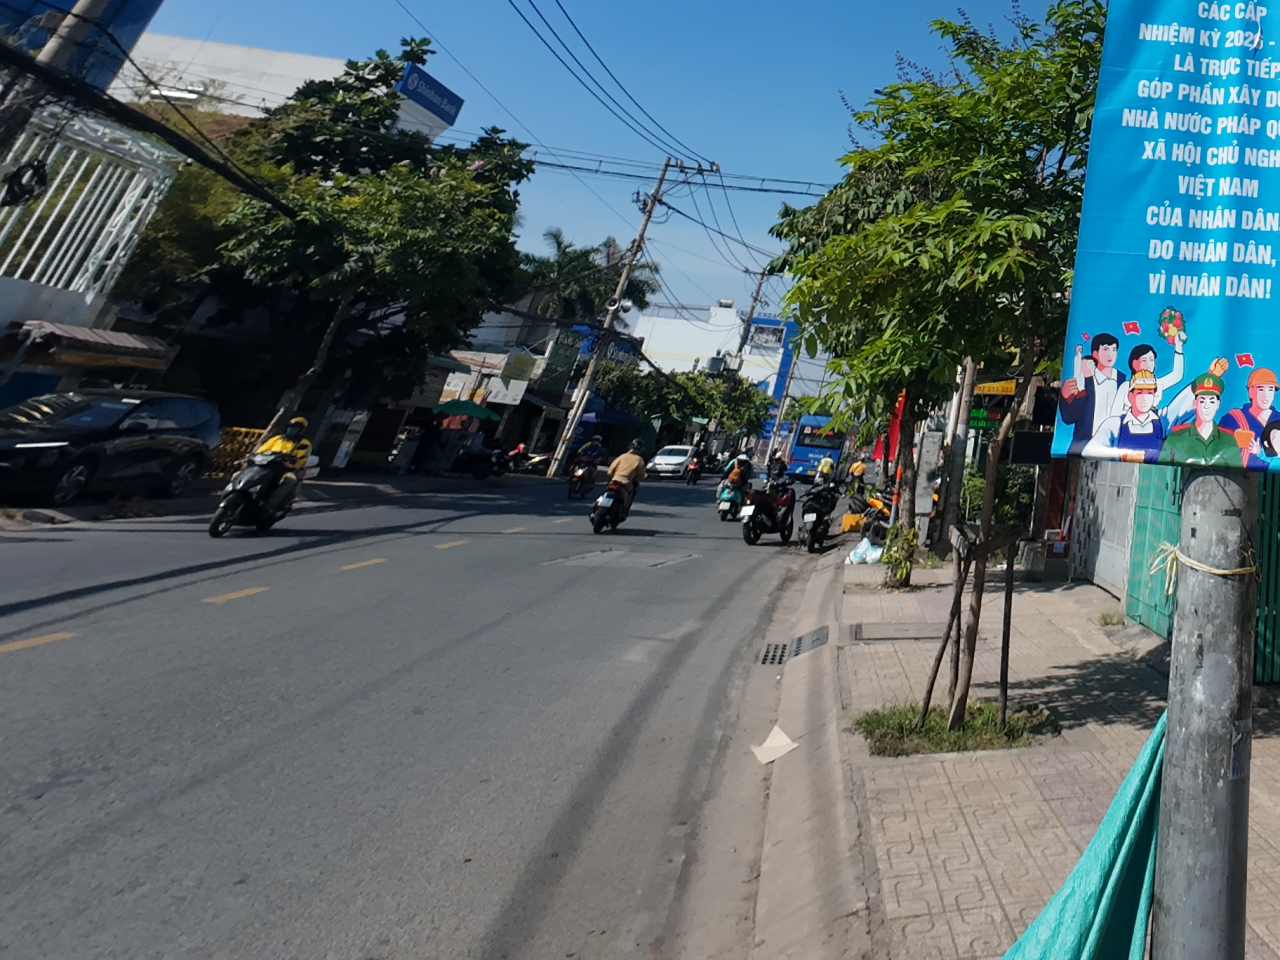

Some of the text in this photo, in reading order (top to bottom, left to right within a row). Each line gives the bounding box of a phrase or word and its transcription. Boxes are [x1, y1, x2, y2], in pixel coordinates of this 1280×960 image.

[1197, 0, 1267, 21] CÁC CẤP
[1139, 22, 1195, 46] NHIỆM
[1200, 27, 1221, 48] KỲ
[1174, 53, 1195, 73] LÀ
[1200, 57, 1240, 80] TRỰC
[1137, 77, 1173, 100] GÓP
[1177, 81, 1224, 105] PHẦN
[1228, 86, 1261, 106] XÂY
[1121, 107, 1159, 129] NHÀ
[1164, 112, 1212, 134] NƯỚC
[1216, 113, 1261, 135] PHÁP
[1141, 138, 1166, 160] XÃ
[1171, 141, 1200, 167] HỘI
[1206, 140, 1239, 166] CHỦ
[1178, 174, 1259, 200] VIỆT NAM
[1145, 200, 1183, 227] CỦA
[1188, 205, 1236, 229] NHÂN
[1148, 239, 1276, 267] DO NHÂN DÂN,
[1148, 269, 1271, 299] VÌ NHÂN DÂN!
